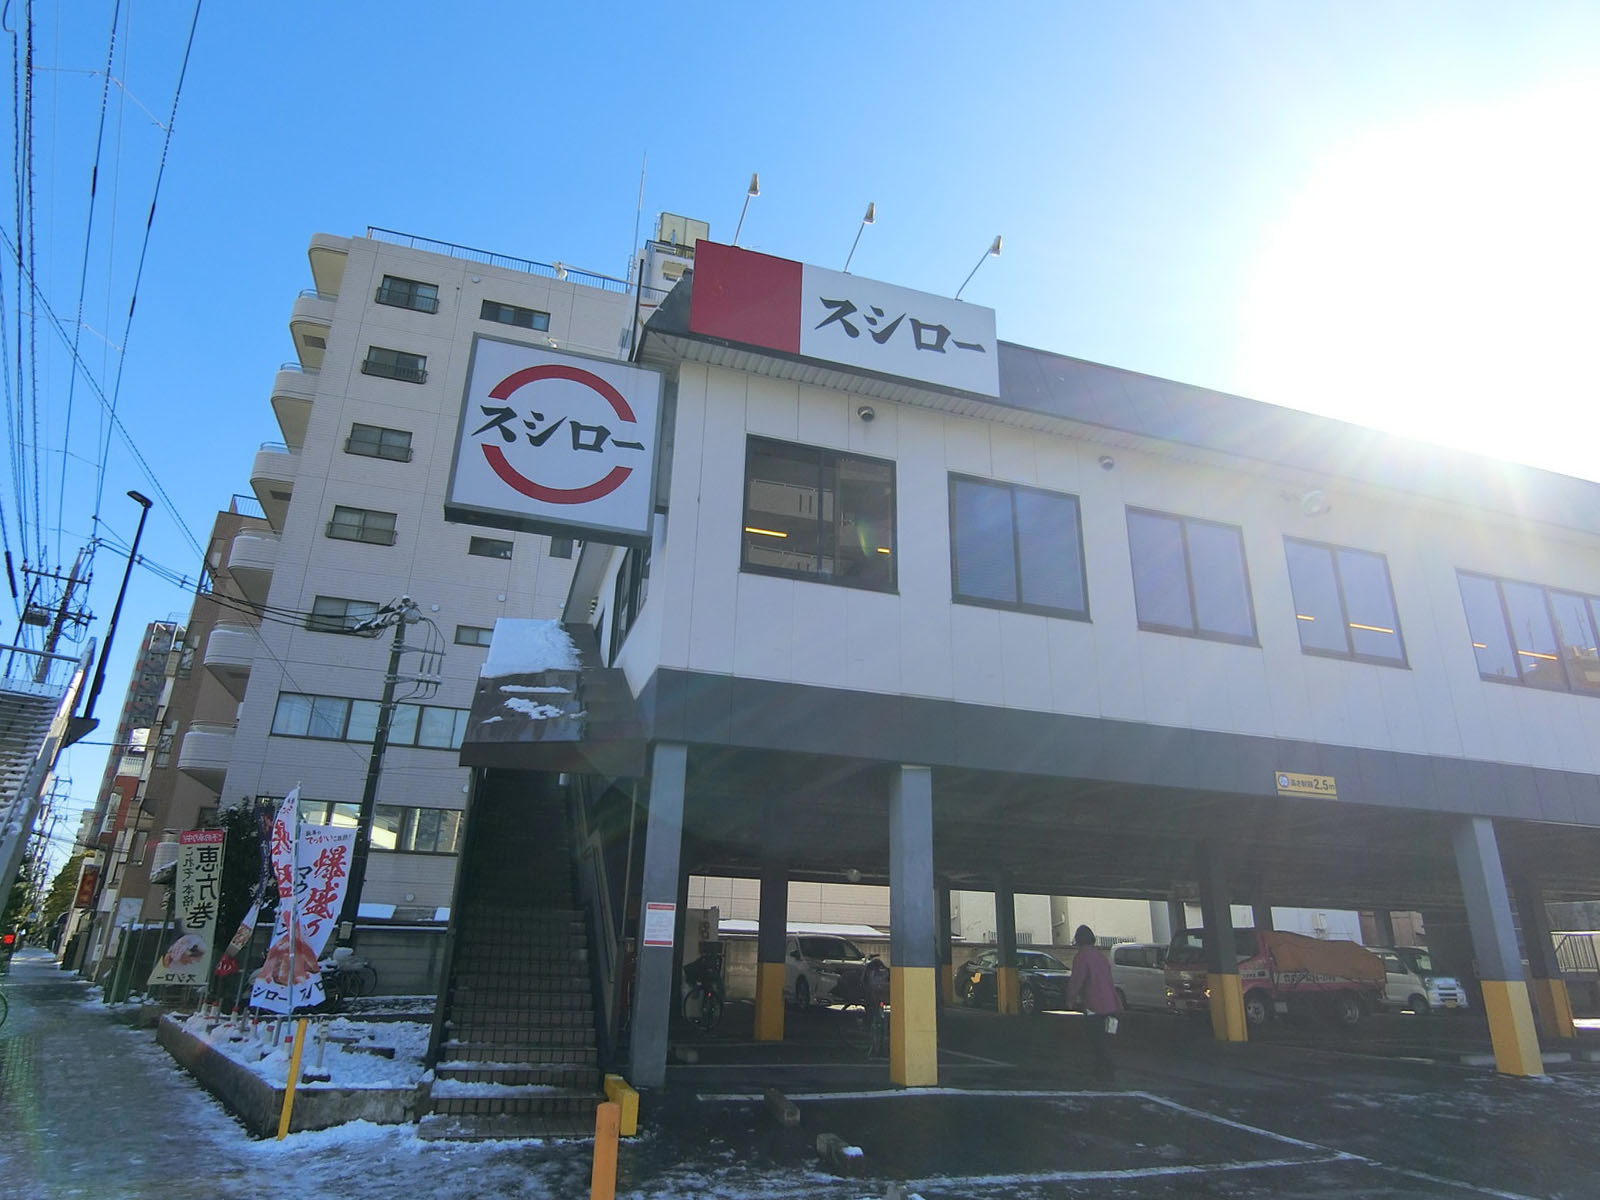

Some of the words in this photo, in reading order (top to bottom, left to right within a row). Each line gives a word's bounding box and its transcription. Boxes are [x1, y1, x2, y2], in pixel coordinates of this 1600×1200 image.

[814, 297, 986, 353] スシロー
[471, 404, 646, 453] スシロー
